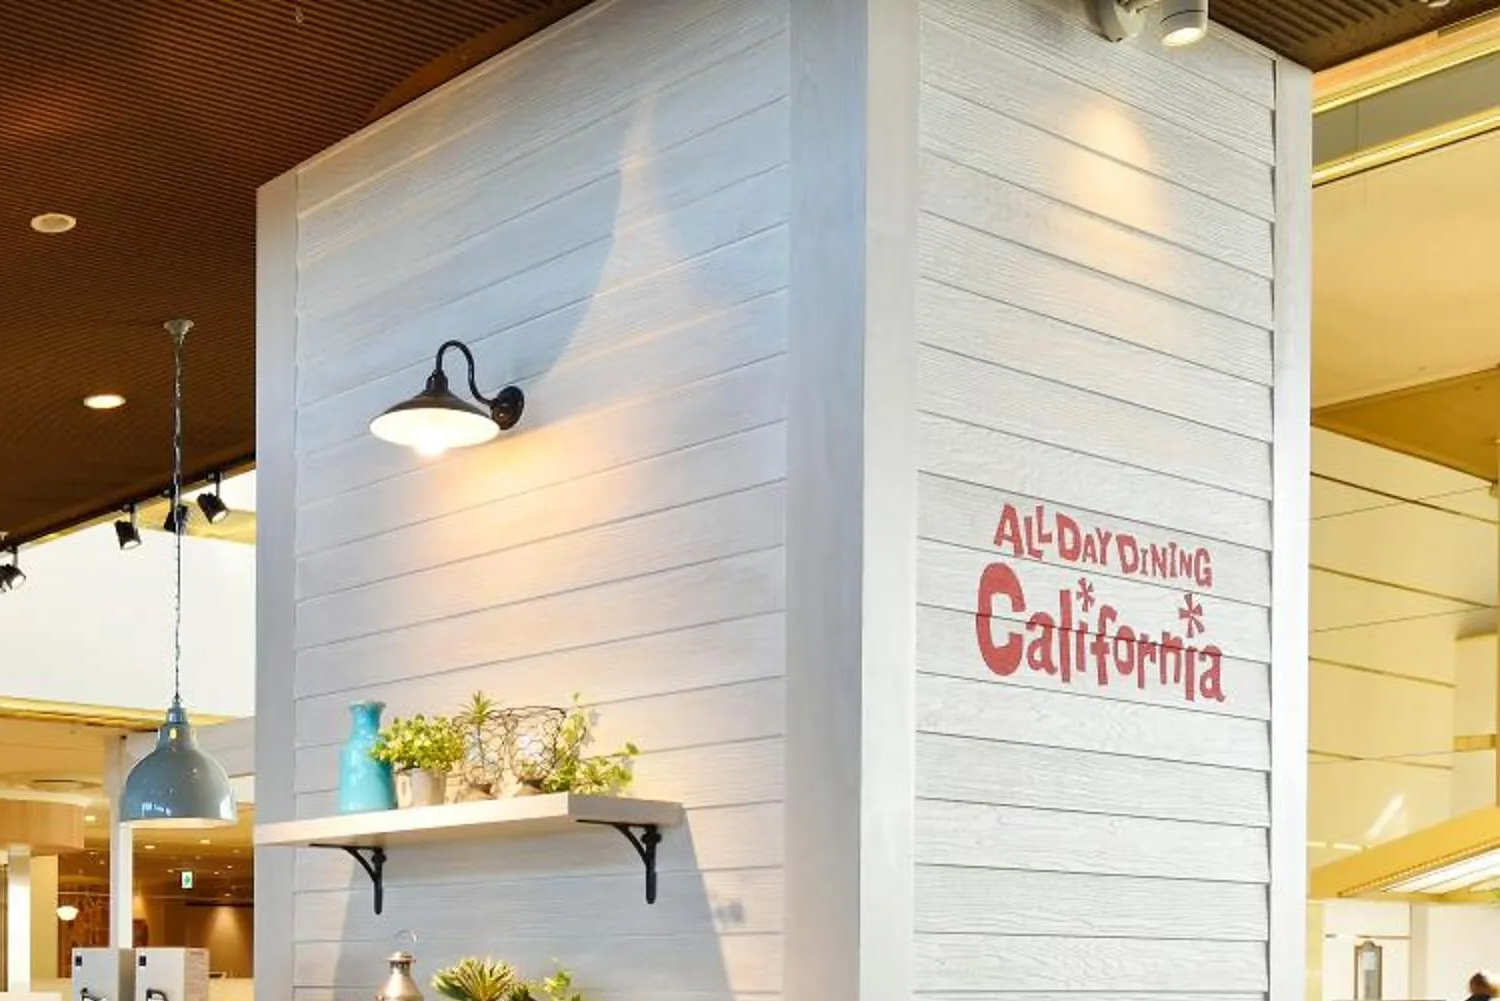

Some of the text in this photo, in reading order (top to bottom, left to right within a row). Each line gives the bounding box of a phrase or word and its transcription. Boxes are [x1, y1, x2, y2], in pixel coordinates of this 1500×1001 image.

[994, 503, 1213, 588] ALL DAY DINING
[975, 562, 1226, 703] California
